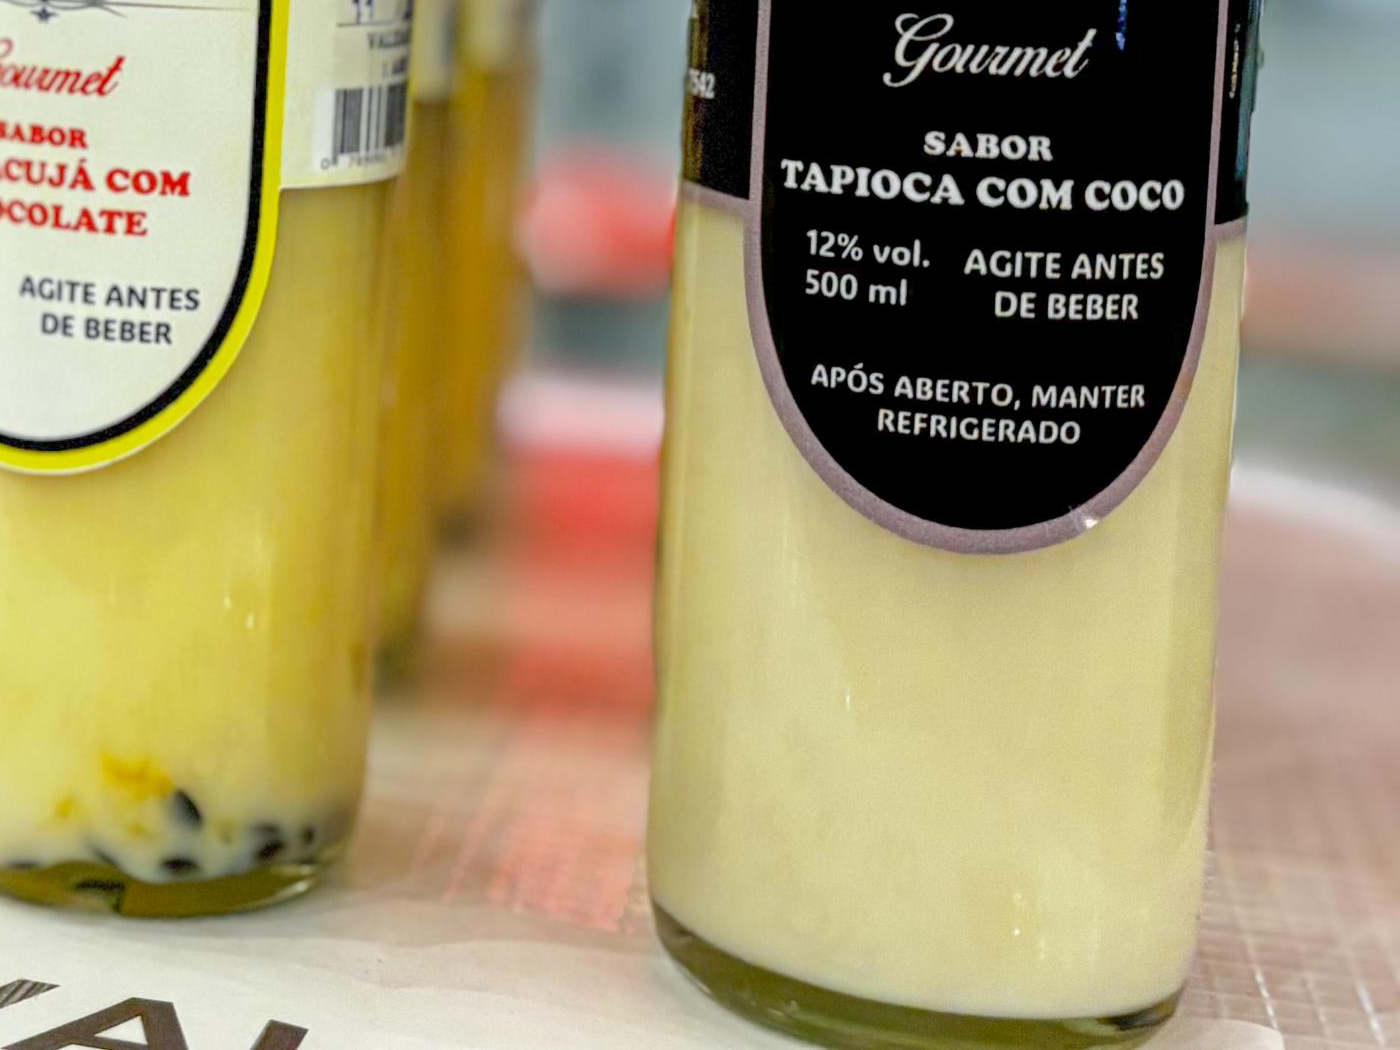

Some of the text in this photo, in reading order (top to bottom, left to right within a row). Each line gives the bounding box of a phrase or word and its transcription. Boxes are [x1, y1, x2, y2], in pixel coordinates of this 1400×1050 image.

[882, 13, 1098, 88] Gourmet
[923, 130, 1054, 162] SABOR
[105, 167, 192, 198] COM
[781, 158, 1186, 212] TAPIOCA COM COCO
[805, 229, 931, 269] 12% vol.
[963, 248, 1166, 281] AGITE ANTES
[19, 274, 201, 312] AGITE ANTES
[805, 268, 908, 307] 500 ml
[994, 290, 1140, 321] DE BEBER
[40, 312, 174, 346] DE BEBER
[810, 362, 1147, 411] APÓS ABERTO, MANTER
[877, 408, 1082, 446] REFRIGERADO
